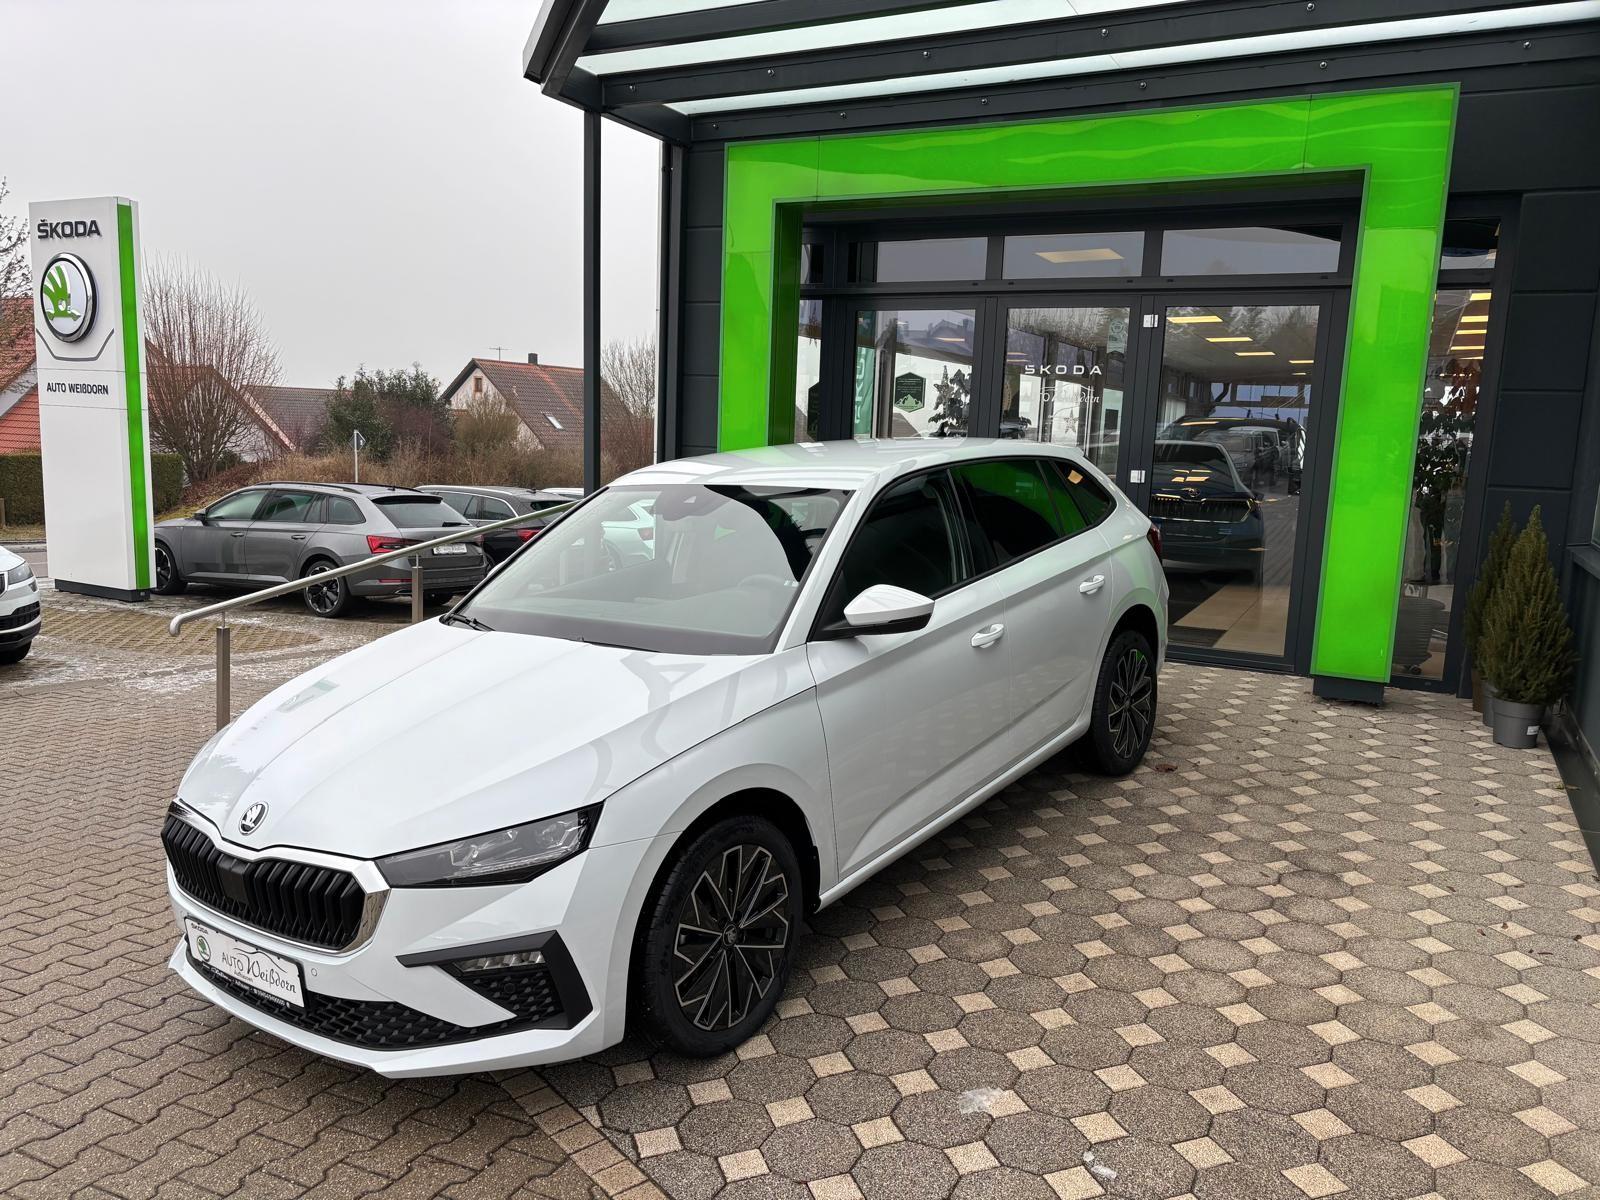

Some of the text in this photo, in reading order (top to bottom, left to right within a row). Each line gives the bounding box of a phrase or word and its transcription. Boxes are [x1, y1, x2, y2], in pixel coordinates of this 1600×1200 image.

[37, 219, 102, 239] ŠKODA
[46, 382, 67, 394] AUTO
[221, 951, 244, 971] AUTO
